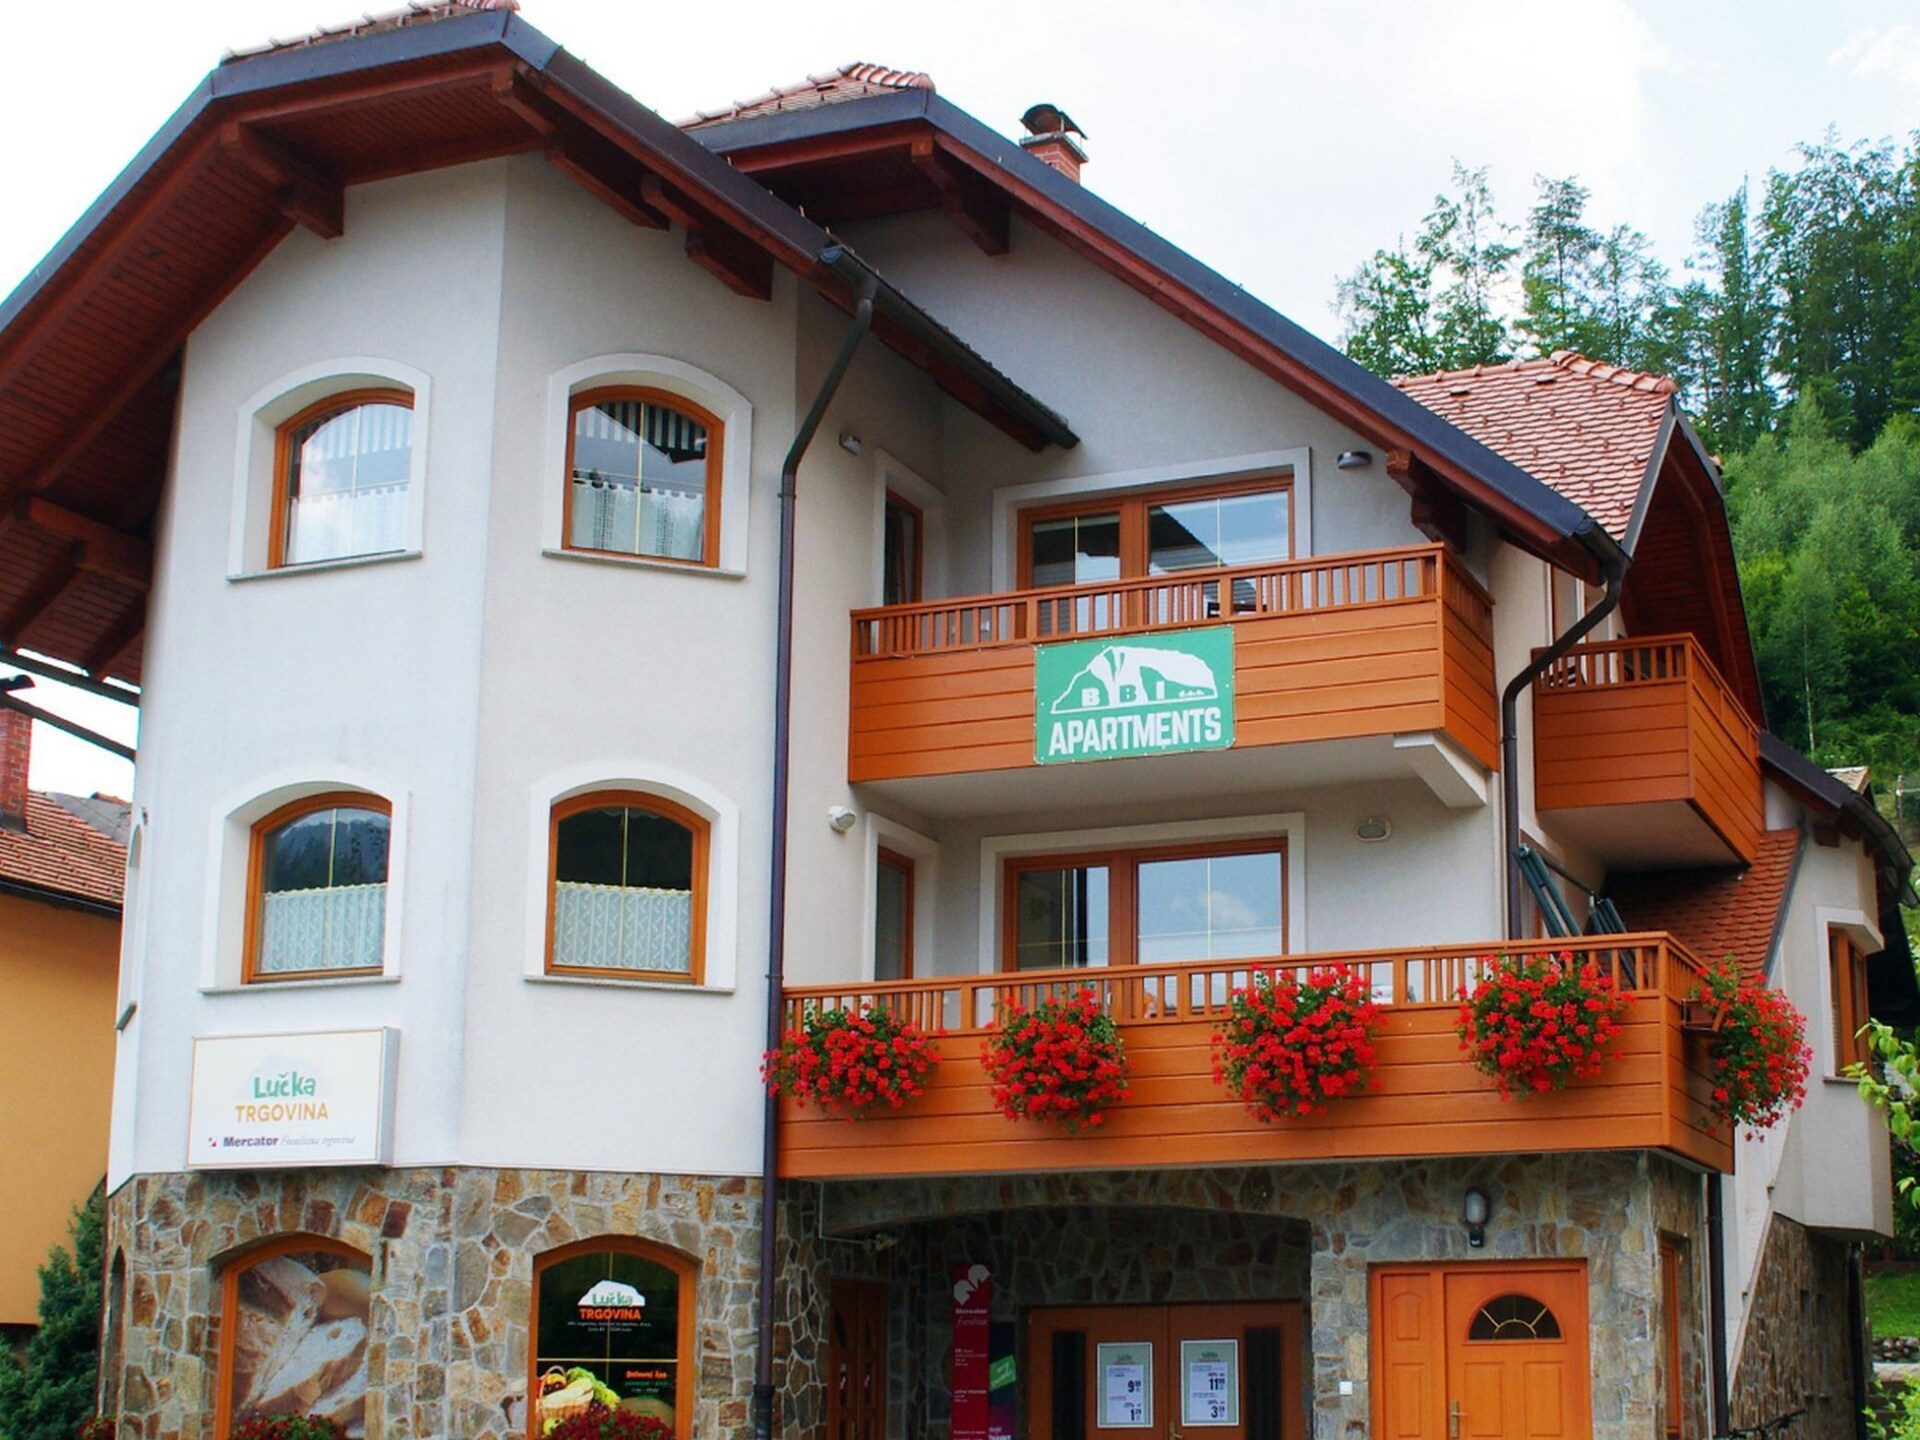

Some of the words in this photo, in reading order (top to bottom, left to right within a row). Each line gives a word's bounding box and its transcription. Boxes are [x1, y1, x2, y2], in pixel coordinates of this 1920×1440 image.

[1049, 707, 1221, 756] APARTMENTS
[254, 1071, 316, 1098] Lučka
[235, 1102, 329, 1123] TRGOVINA
[223, 1136, 278, 1148] Mercator
[593, 1292, 633, 1306] Lučka
[579, 1308, 641, 1320] TRGOVINA
